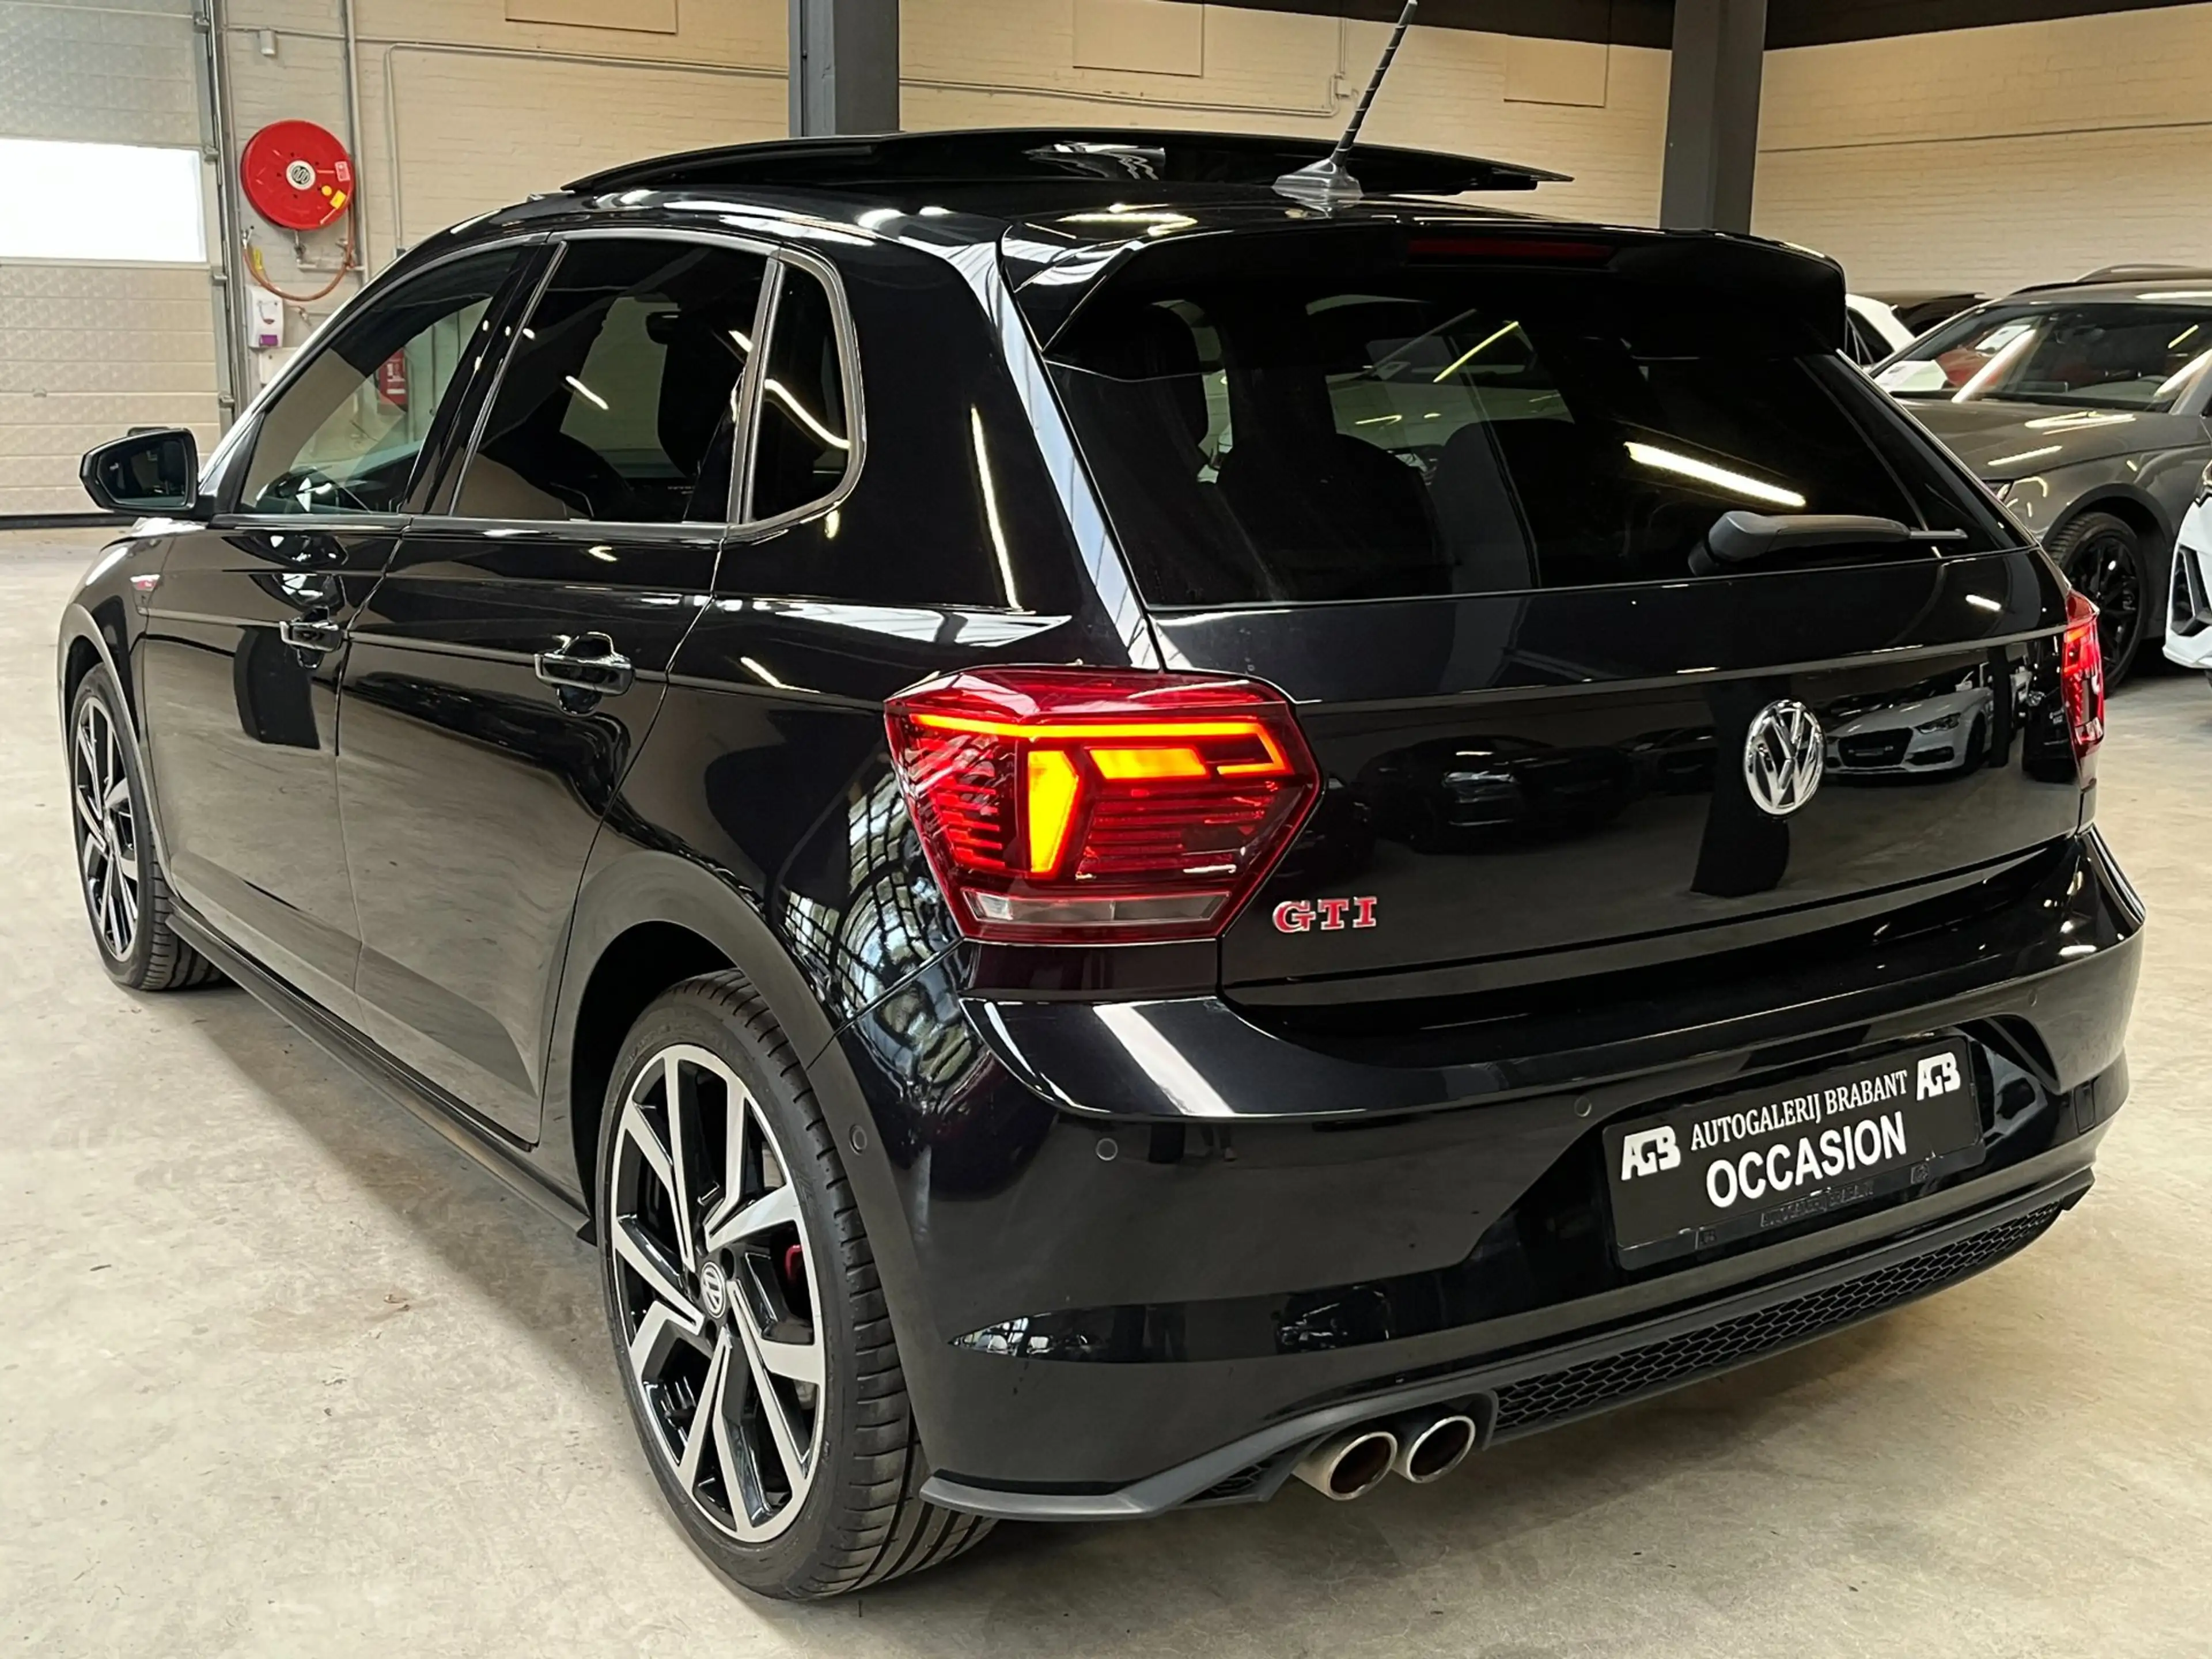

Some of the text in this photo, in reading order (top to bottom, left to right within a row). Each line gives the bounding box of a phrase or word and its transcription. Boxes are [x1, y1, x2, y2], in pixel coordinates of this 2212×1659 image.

[1272, 896, 1377, 933] GTI
[1621, 1051, 1961, 1181] AGB AUTOGALERIJ BRABANT AGB
[1706, 1111, 1907, 1208] OCCASION
